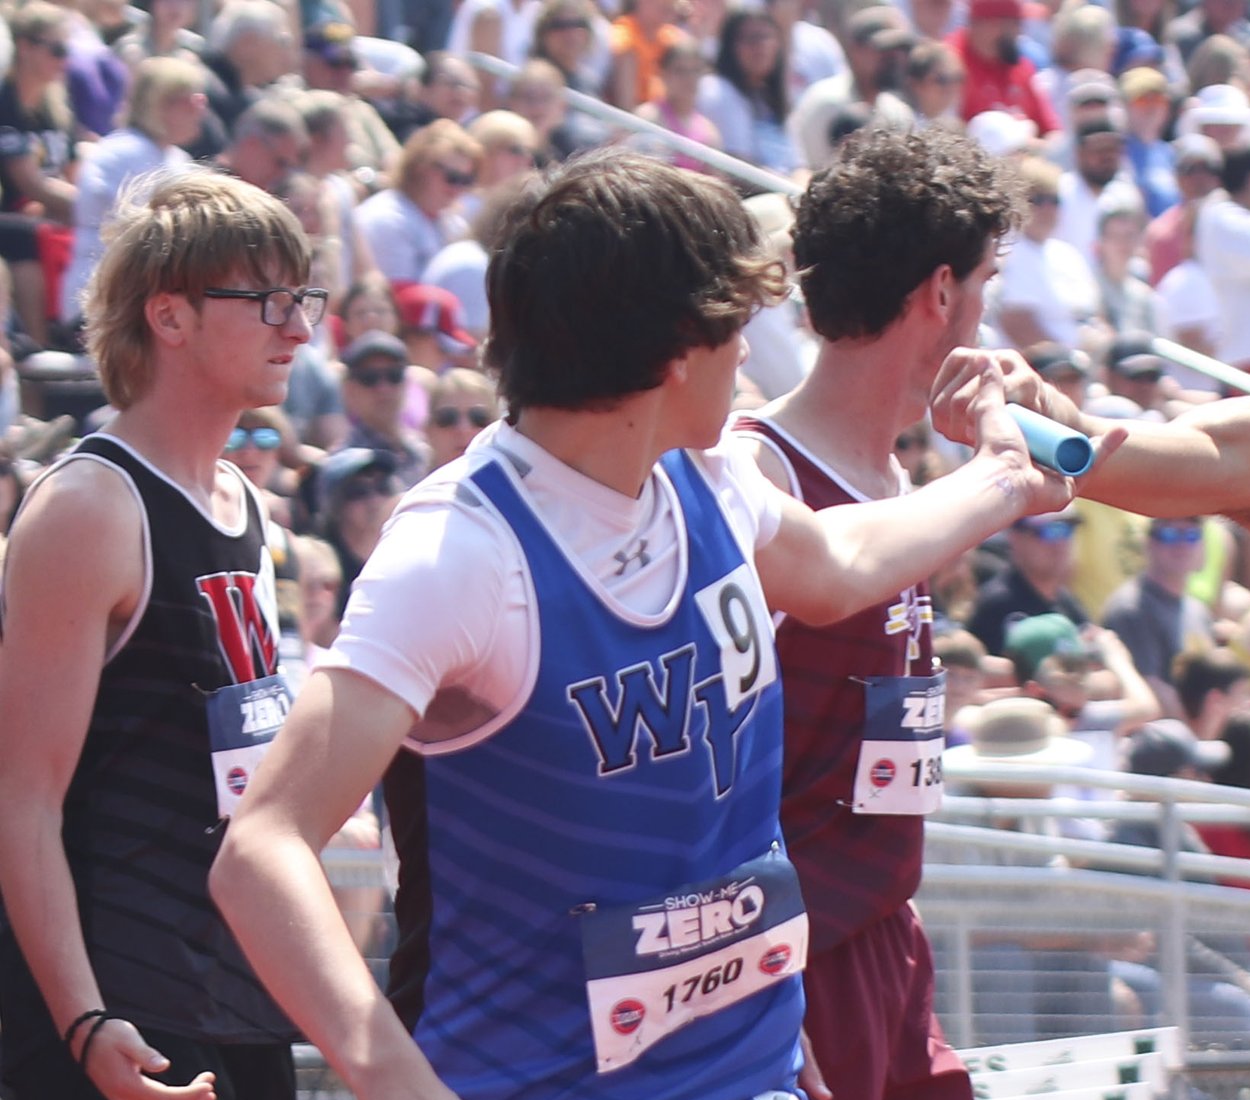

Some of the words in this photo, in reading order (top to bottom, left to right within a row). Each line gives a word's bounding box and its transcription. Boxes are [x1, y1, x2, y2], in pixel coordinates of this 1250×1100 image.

[720, 581, 761, 693] 9
[631, 884, 765, 956] ZERO
[664, 881, 739, 911] SHOW-ME
[663, 957, 744, 1013] 1760
